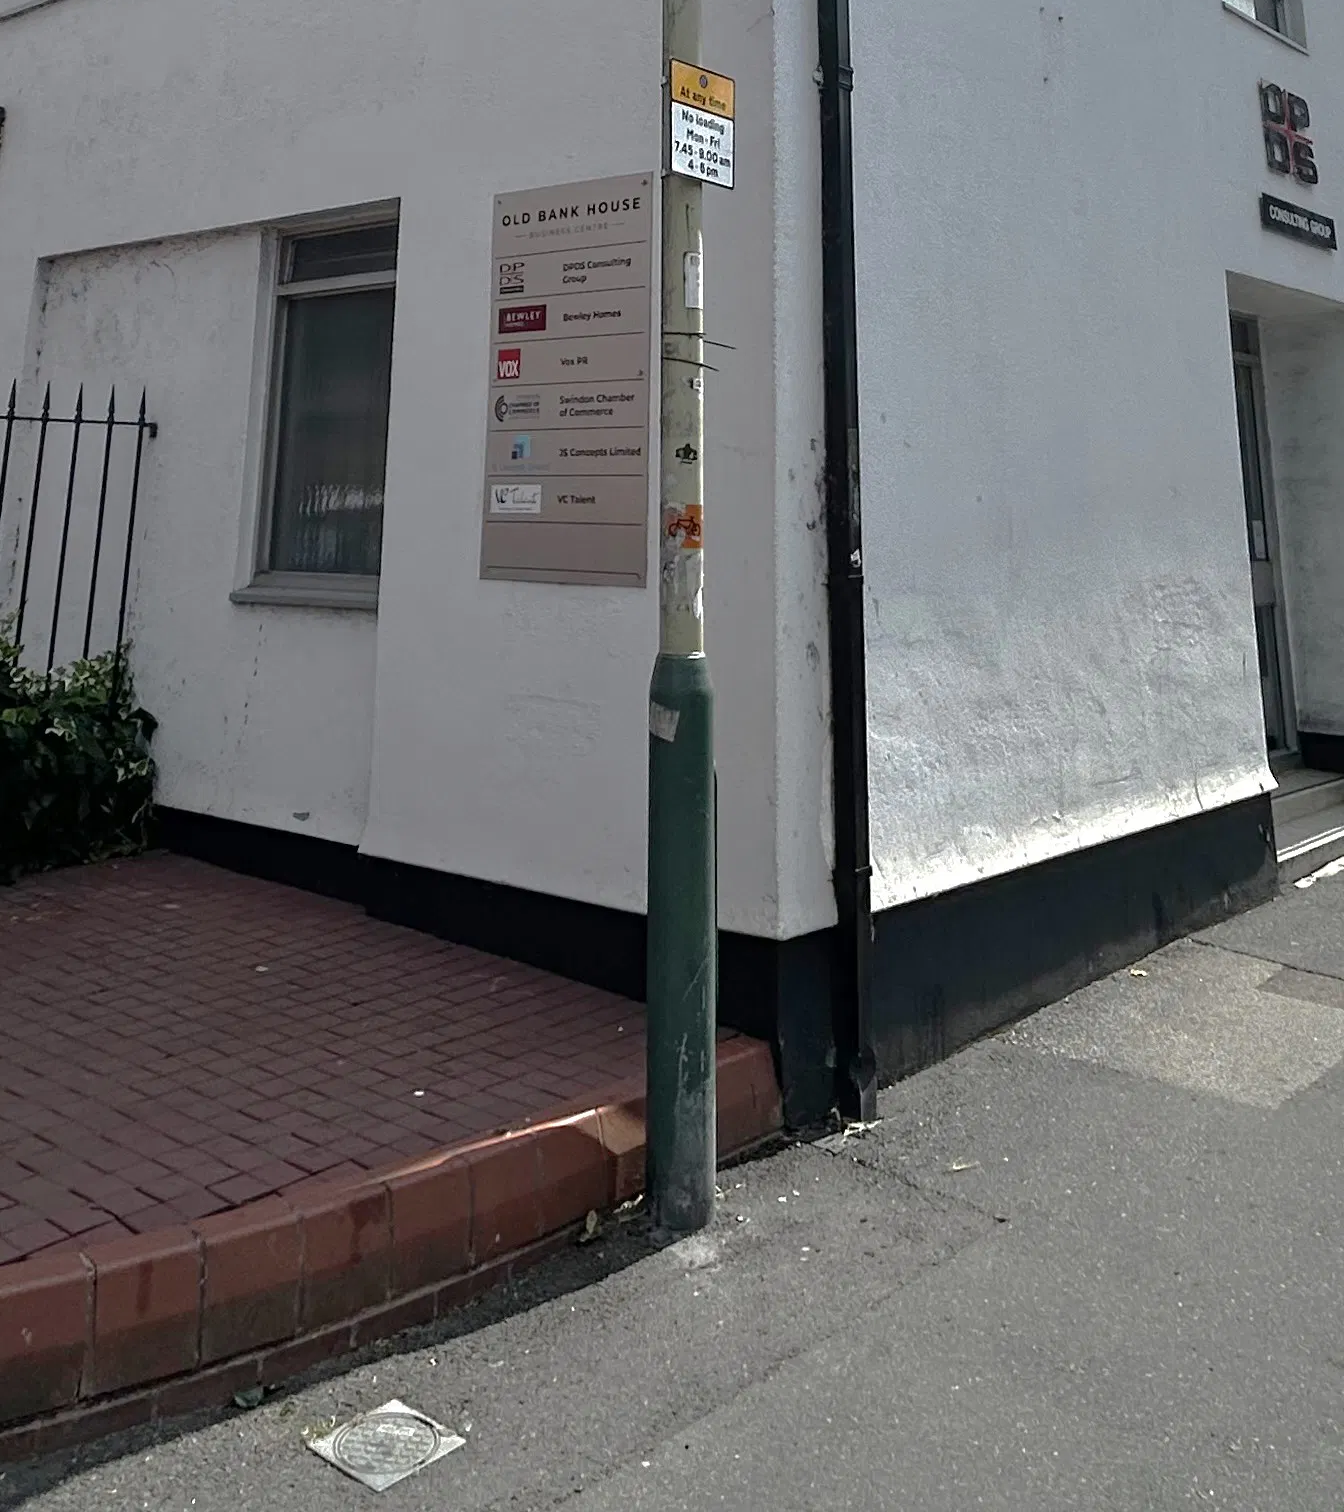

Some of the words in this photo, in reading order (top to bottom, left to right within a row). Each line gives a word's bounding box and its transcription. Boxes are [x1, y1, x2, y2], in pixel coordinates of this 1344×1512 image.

[680, 86, 690, 99] At
[692, 92, 706, 106] any
[709, 95, 726, 110] time
[682, 109, 694, 124] No
[696, 114, 724, 135] loading
[686, 128, 704, 143] Mon
[710, 136, 720, 150] Fri
[674, 140, 693, 156] 7.45
[719, 156, 731, 168] am
[688, 158, 694, 170] 4
[706, 166, 718, 178] pm
[502, 212, 530, 226] OLD
[538, 206, 580, 222] BANK
[587, 197, 641, 215] HOUSE
[1269, 204, 1309, 232] CONSULTING
[1310, 219, 1332, 238] GROUP
[528, 225, 571, 239] BUSINESS
[574, 222, 609, 234] CENTRE
[562, 262, 586, 272] DPDS
[587, 257, 632, 270] Consulting
[562, 274, 587, 284] Group
[506, 310, 541, 322] BEWLEY
[563, 312, 591, 322] Bewley
[593, 309, 621, 319] Homes
[498, 360, 519, 378] VOX
[560, 358, 574, 366] Vox
[576, 356, 588, 365] PR
[560, 396, 594, 404] Swindon
[596, 394, 634, 402] Chamber
[560, 408, 568, 416] of
[570, 408, 614, 416] Commerce
[570, 448, 608, 458] Concepts
[609, 446, 641, 456] Limited
[556, 495, 568, 504] VC
[570, 495, 596, 504] Talent
